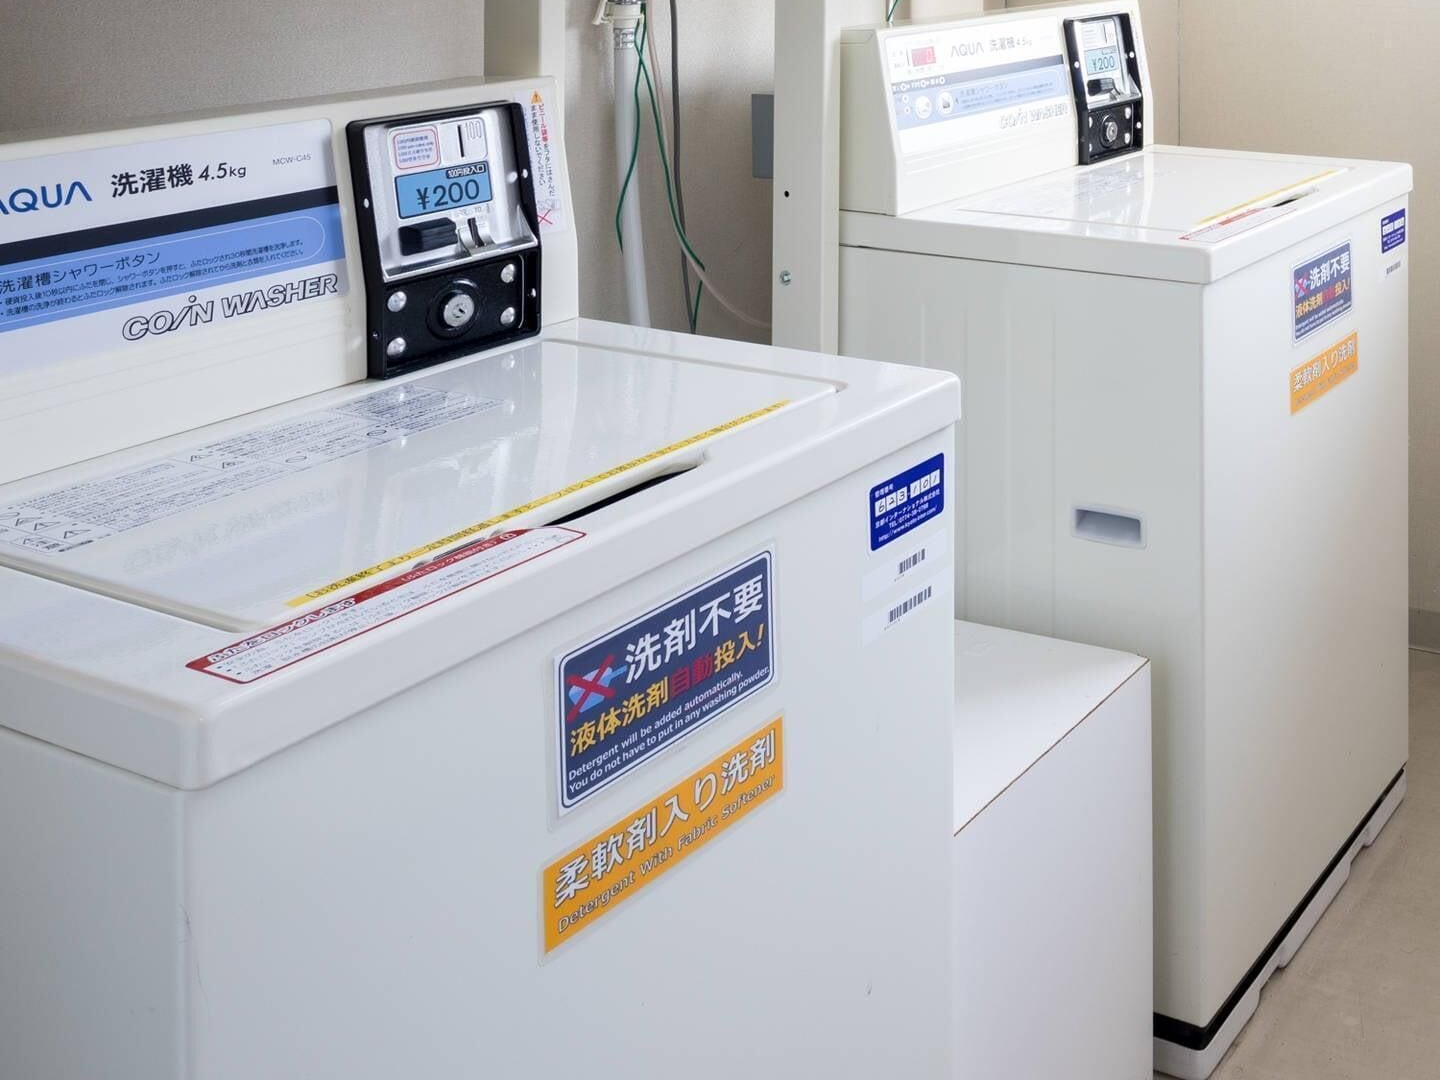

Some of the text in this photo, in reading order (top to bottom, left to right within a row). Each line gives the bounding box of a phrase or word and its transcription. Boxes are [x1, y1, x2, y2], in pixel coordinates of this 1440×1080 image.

[950, 41, 985, 58] AQUA
[1093, 55, 1115, 72] ¥200
[110, 162, 194, 199] 洗濯機
[197, 159, 247, 183] 4.5kg
[416, 179, 479, 210] ¥200
[0, 250, 160, 294] 洗濯槽シャワーボタン
[1309, 251, 1350, 290] 洗剤不要
[121, 272, 338, 342] COIN WASHER
[624, 572, 763, 685] 洗剤不要
[570, 621, 763, 757] 液体洗剤自動投入!
[568, 668, 742, 783] Detergent will be added automatically.
[569, 664, 769, 795] You do not have to put in any washing powder.
[553, 728, 774, 910] 柔軟剤入り洗剤
[558, 772, 773, 937] Detergent With Fabric Softener
